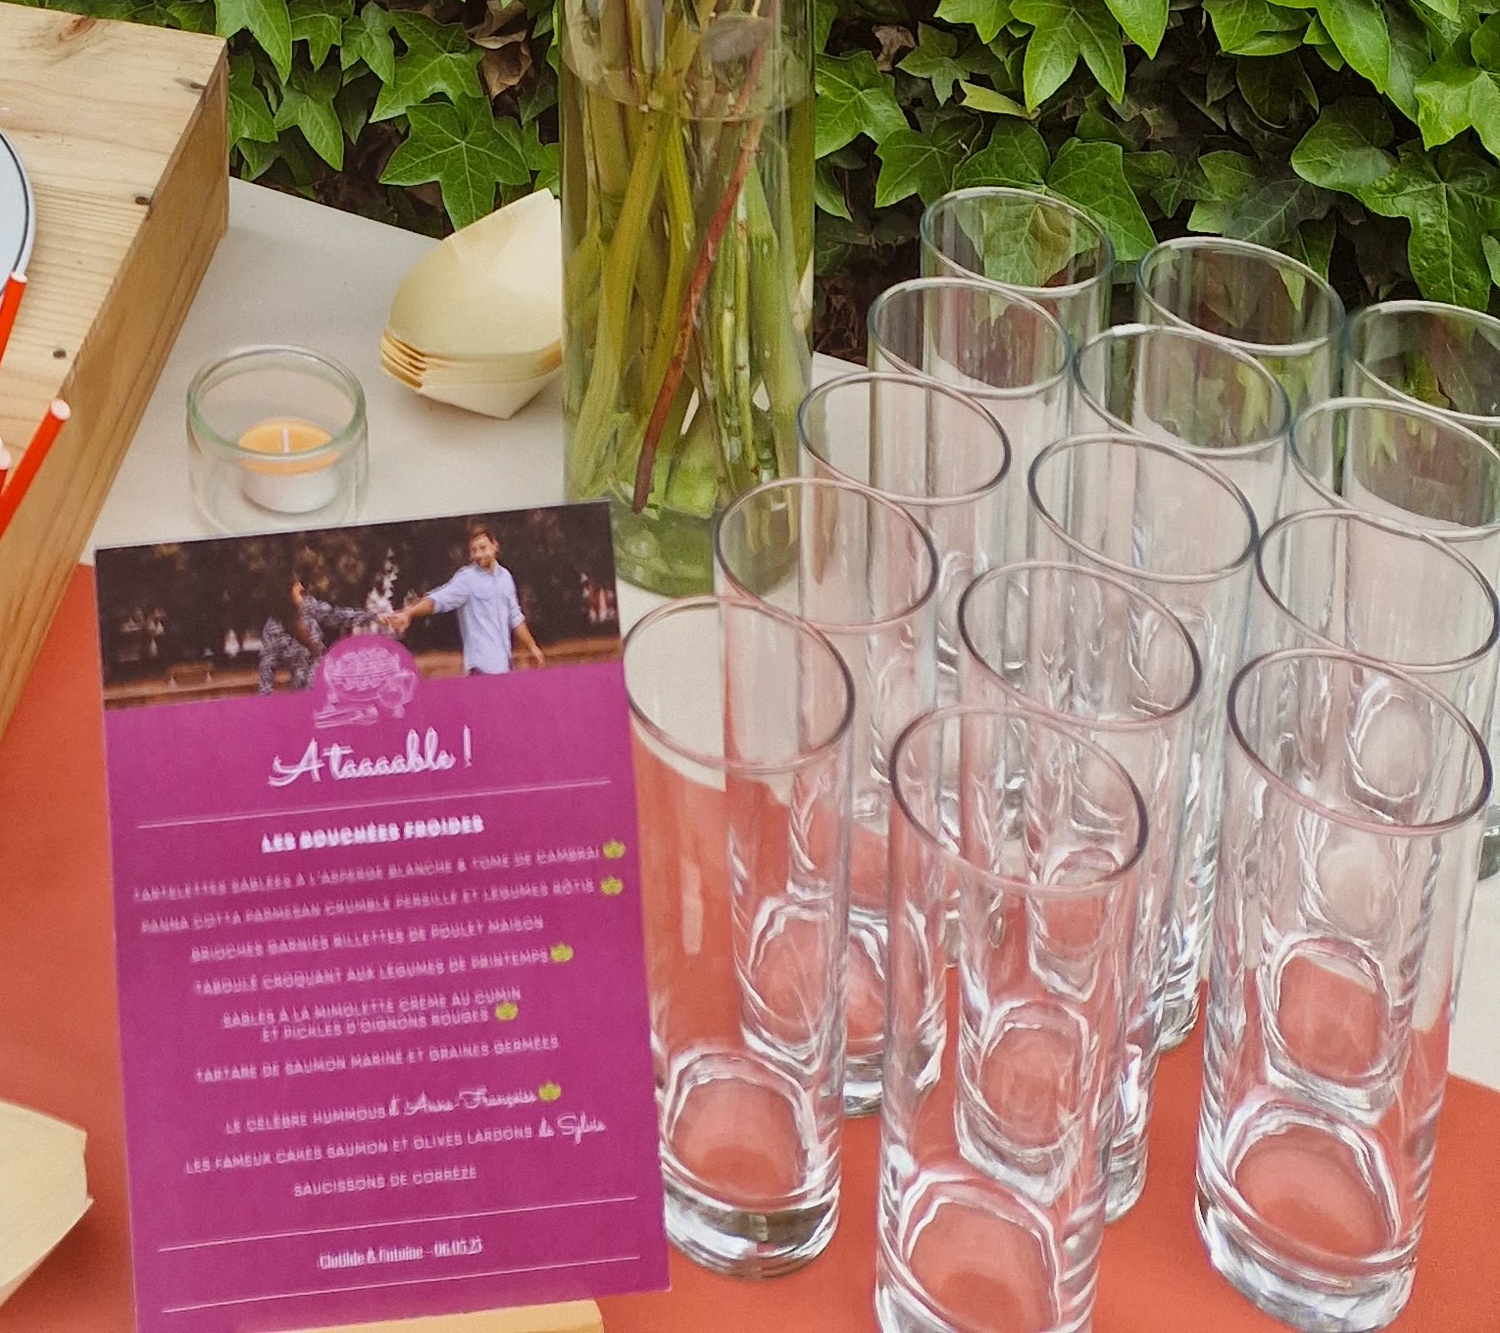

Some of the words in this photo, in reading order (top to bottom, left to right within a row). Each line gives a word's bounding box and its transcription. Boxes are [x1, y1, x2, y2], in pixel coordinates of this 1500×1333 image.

[262, 834, 296, 853] LES
[404, 814, 484, 839] FROIDES
[310, 866, 383, 885] L'ASPERGE
[388, 860, 452, 879] BLANCHE
[458, 858, 467, 873] &
[472, 854, 510, 870] TOME
[514, 852, 532, 867] DE
[140, 917, 190, 934] PANNA
[194, 911, 243, 930] COTTA
[246, 904, 320, 923] PARMESAN
[326, 897, 390, 916] CRUMBLE
[462, 888, 479, 904] ET
[191, 942, 264, 963] BRIOCHES
[267, 935, 328, 955] GARNIES
[333, 929, 404, 948] RILLETTES
[408, 926, 426, 943] DE
[431, 921, 484, 939] POULET
[488, 916, 544, 933] MAISON
[262, 968, 342, 990] CROQUANT
[346, 966, 375, 982] AUX
[448, 956, 466, 973] DE
[471, 949, 549, 969] PRINTEMPS
[292, 1005, 310, 1021] LA
[314, 998, 394, 1019] MIMOLETTE
[451, 992, 470, 1007] AU
[474, 986, 521, 1005] CUMIN
[262, 1026, 278, 1042] ET
[284, 1024, 342, 1039] PICKLES
[346, 1016, 426, 1035] D'OIGNONS
[432, 1008, 489, 1027] ROUGES
[195, 1064, 257, 1083] TARTARE
[262, 1061, 279, 1078] DE
[284, 1056, 346, 1076] SAUMON
[408, 1047, 424, 1064] ET
[429, 1042, 489, 1062] GRAINES
[226, 1117, 241, 1135] LE
[313, 1104, 386, 1125] HUMMOUS
[186, 1157, 210, 1174] LES
[216, 1152, 272, 1169] FAMEUX
[276, 1146, 322, 1164] CAKES
[328, 1140, 388, 1159] SAUMON
[393, 1136, 408, 1152] ET
[414, 1132, 462, 1150] OLIVES
[467, 1125, 532, 1144] LARDONS
[538, 1117, 554, 1138] de
[294, 1175, 386, 1197] SAUCISSONS
[390, 1172, 408, 1187] DE
[366, 1247, 376, 1265] &
